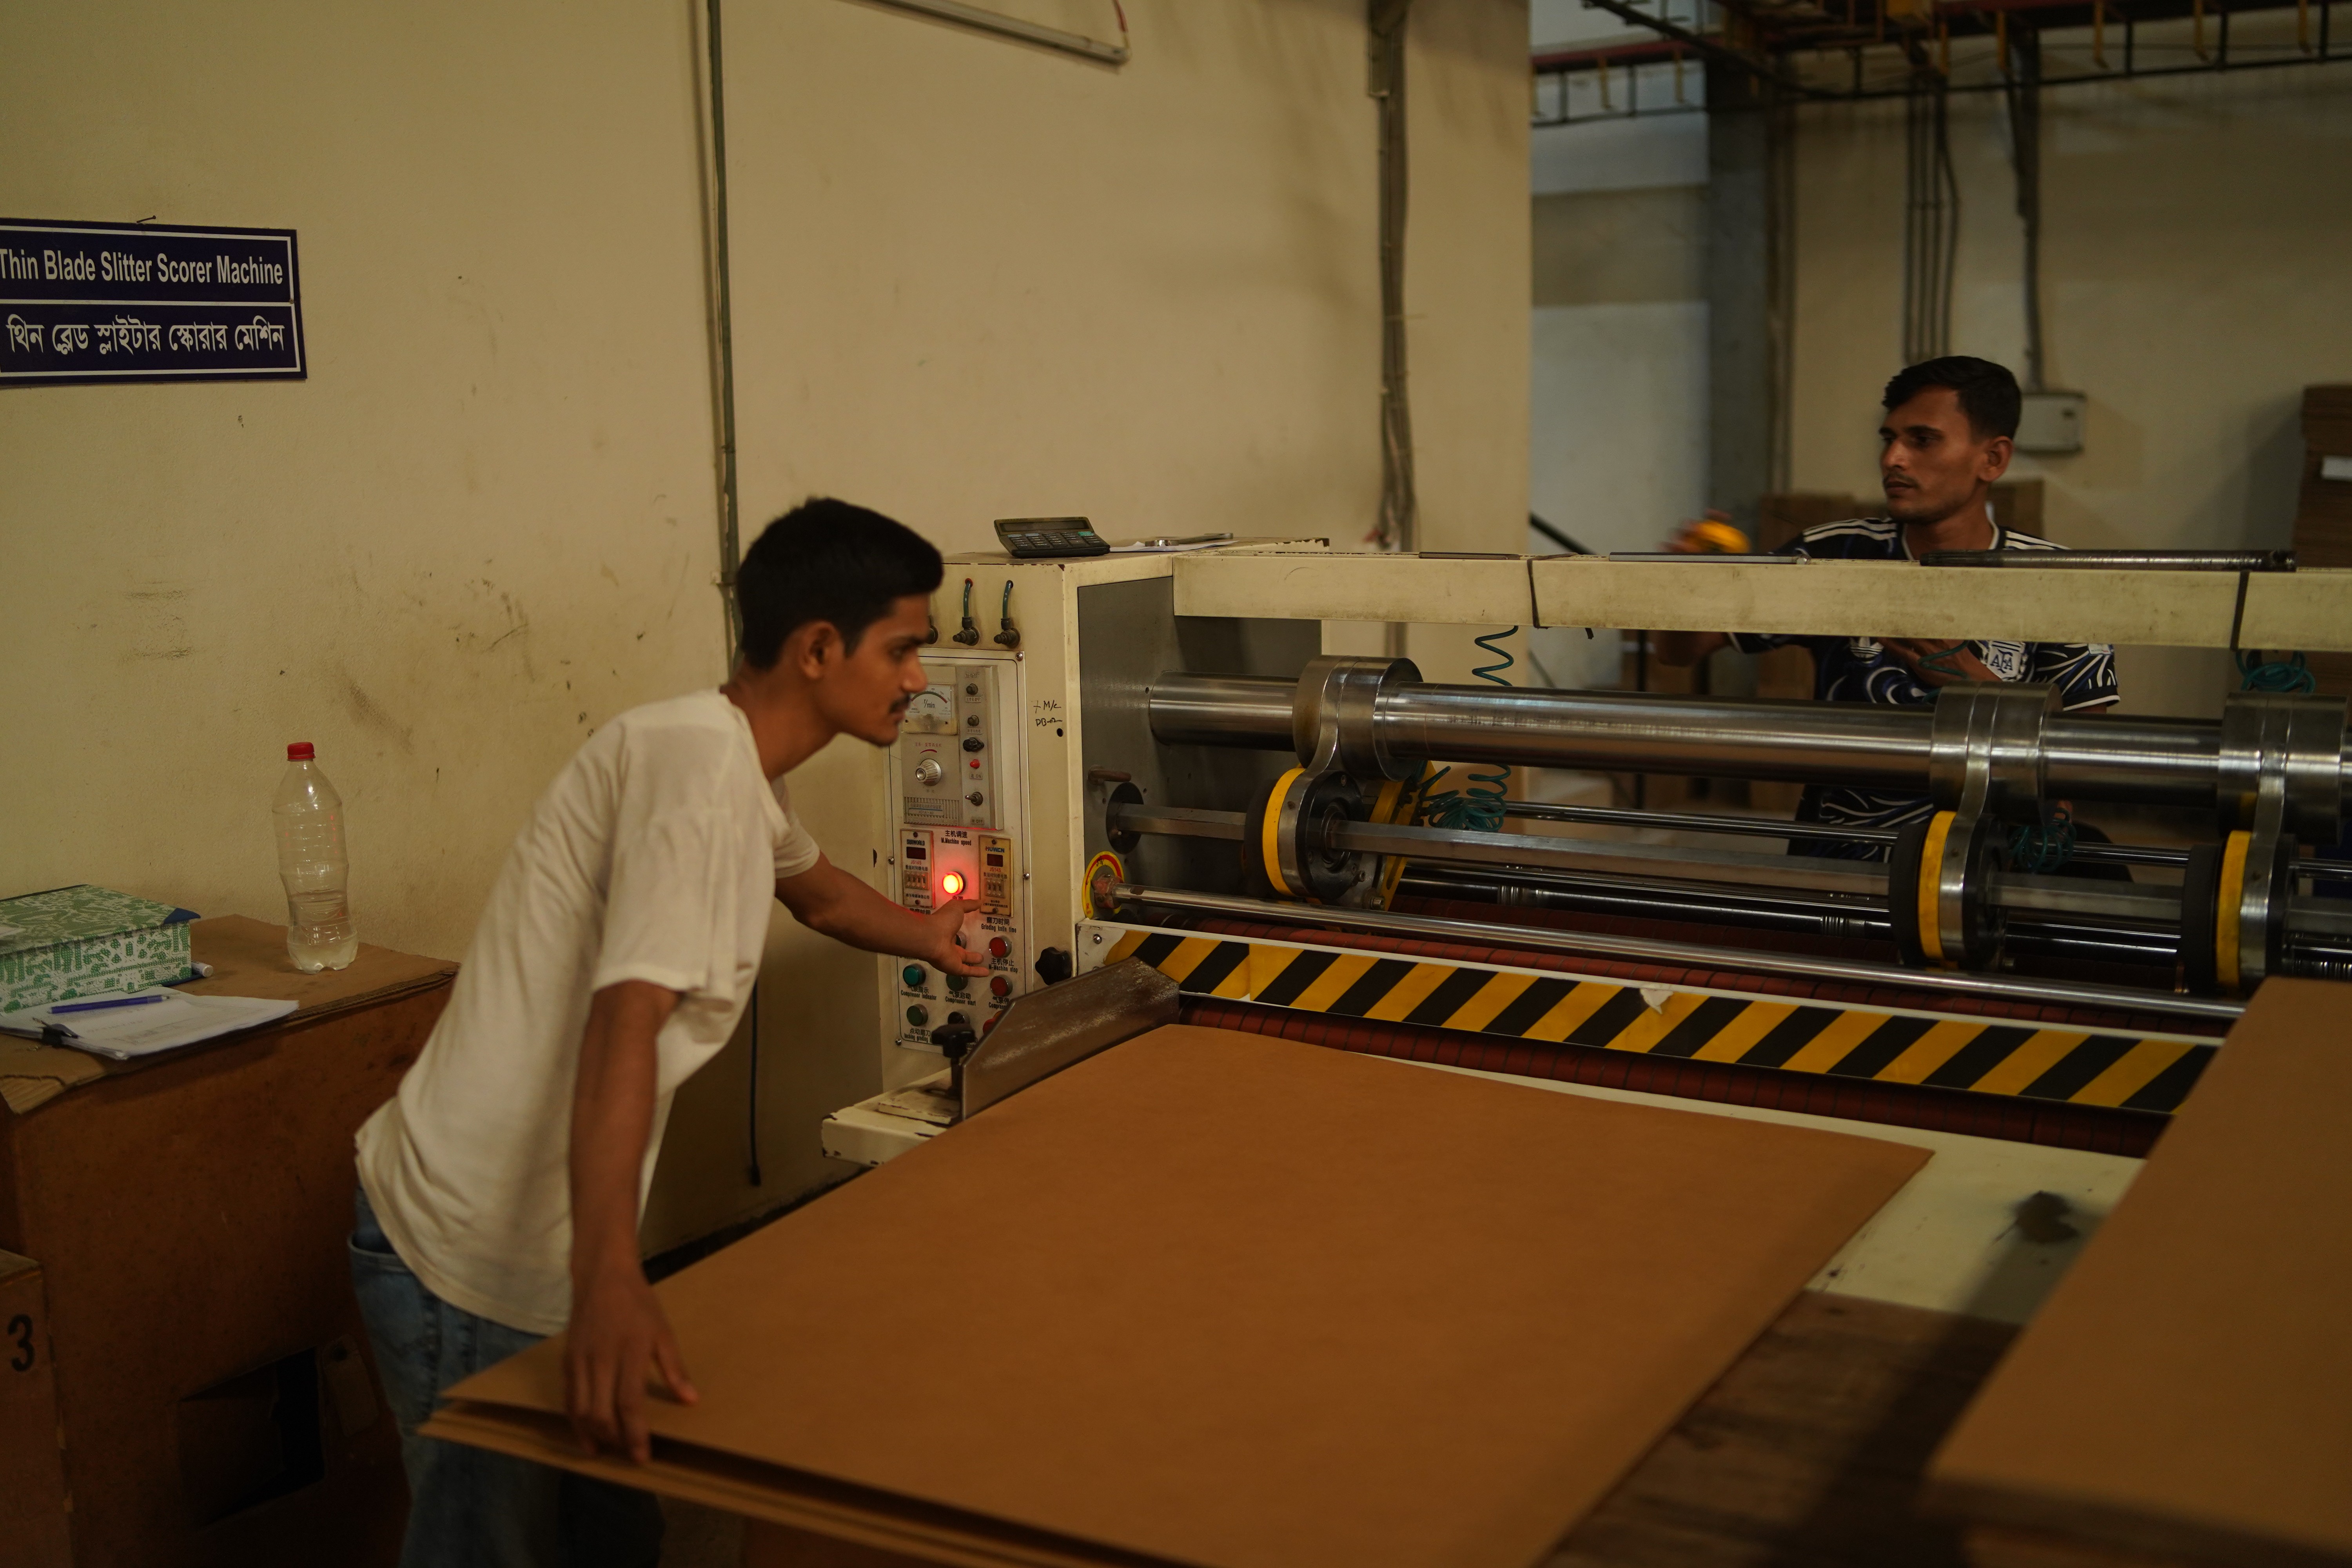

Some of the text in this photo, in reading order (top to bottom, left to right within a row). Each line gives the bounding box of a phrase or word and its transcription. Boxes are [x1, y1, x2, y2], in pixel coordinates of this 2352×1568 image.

[0, 249, 283, 284] Thin Blade Slitter Scorer Machine
[5, 314, 285, 355] থিন ব্লেড স্লাইটার স্কোরার মেশিন
[924, 699, 935, 708] r/min
[945, 829, 968, 838] 主机调速
[987, 916, 1010, 926] 磨刀时间
[981, 924, 996, 932] Grinding
[991, 957, 1014, 966] 主机停止
[901, 990, 920, 998] Compressor
[949, 990, 971, 1000] 气泵启动
[945, 996, 965, 1005] Compressor
[992, 996, 1011, 1005] 气泵停
[7, 1313, 36, 1371] 3
